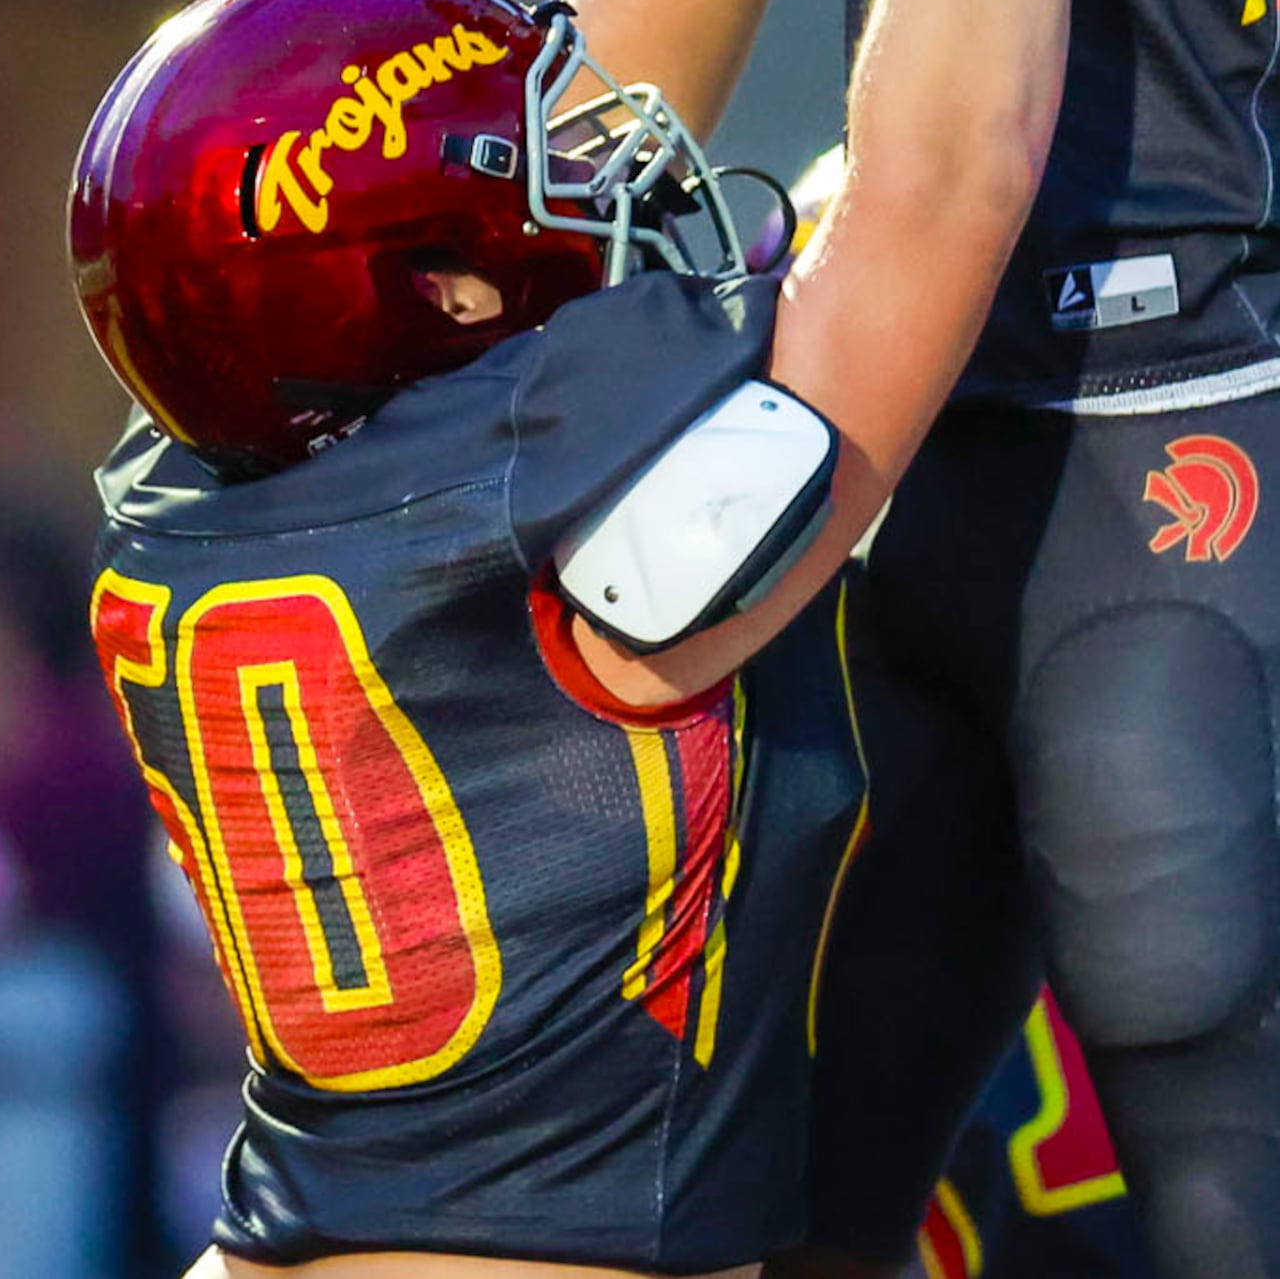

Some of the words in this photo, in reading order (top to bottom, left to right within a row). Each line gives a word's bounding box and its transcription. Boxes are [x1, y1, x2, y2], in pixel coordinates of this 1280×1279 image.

[258, 23, 509, 234] Trojans
[1131, 295, 1146, 312] L
[90, 566, 503, 1093] 50
